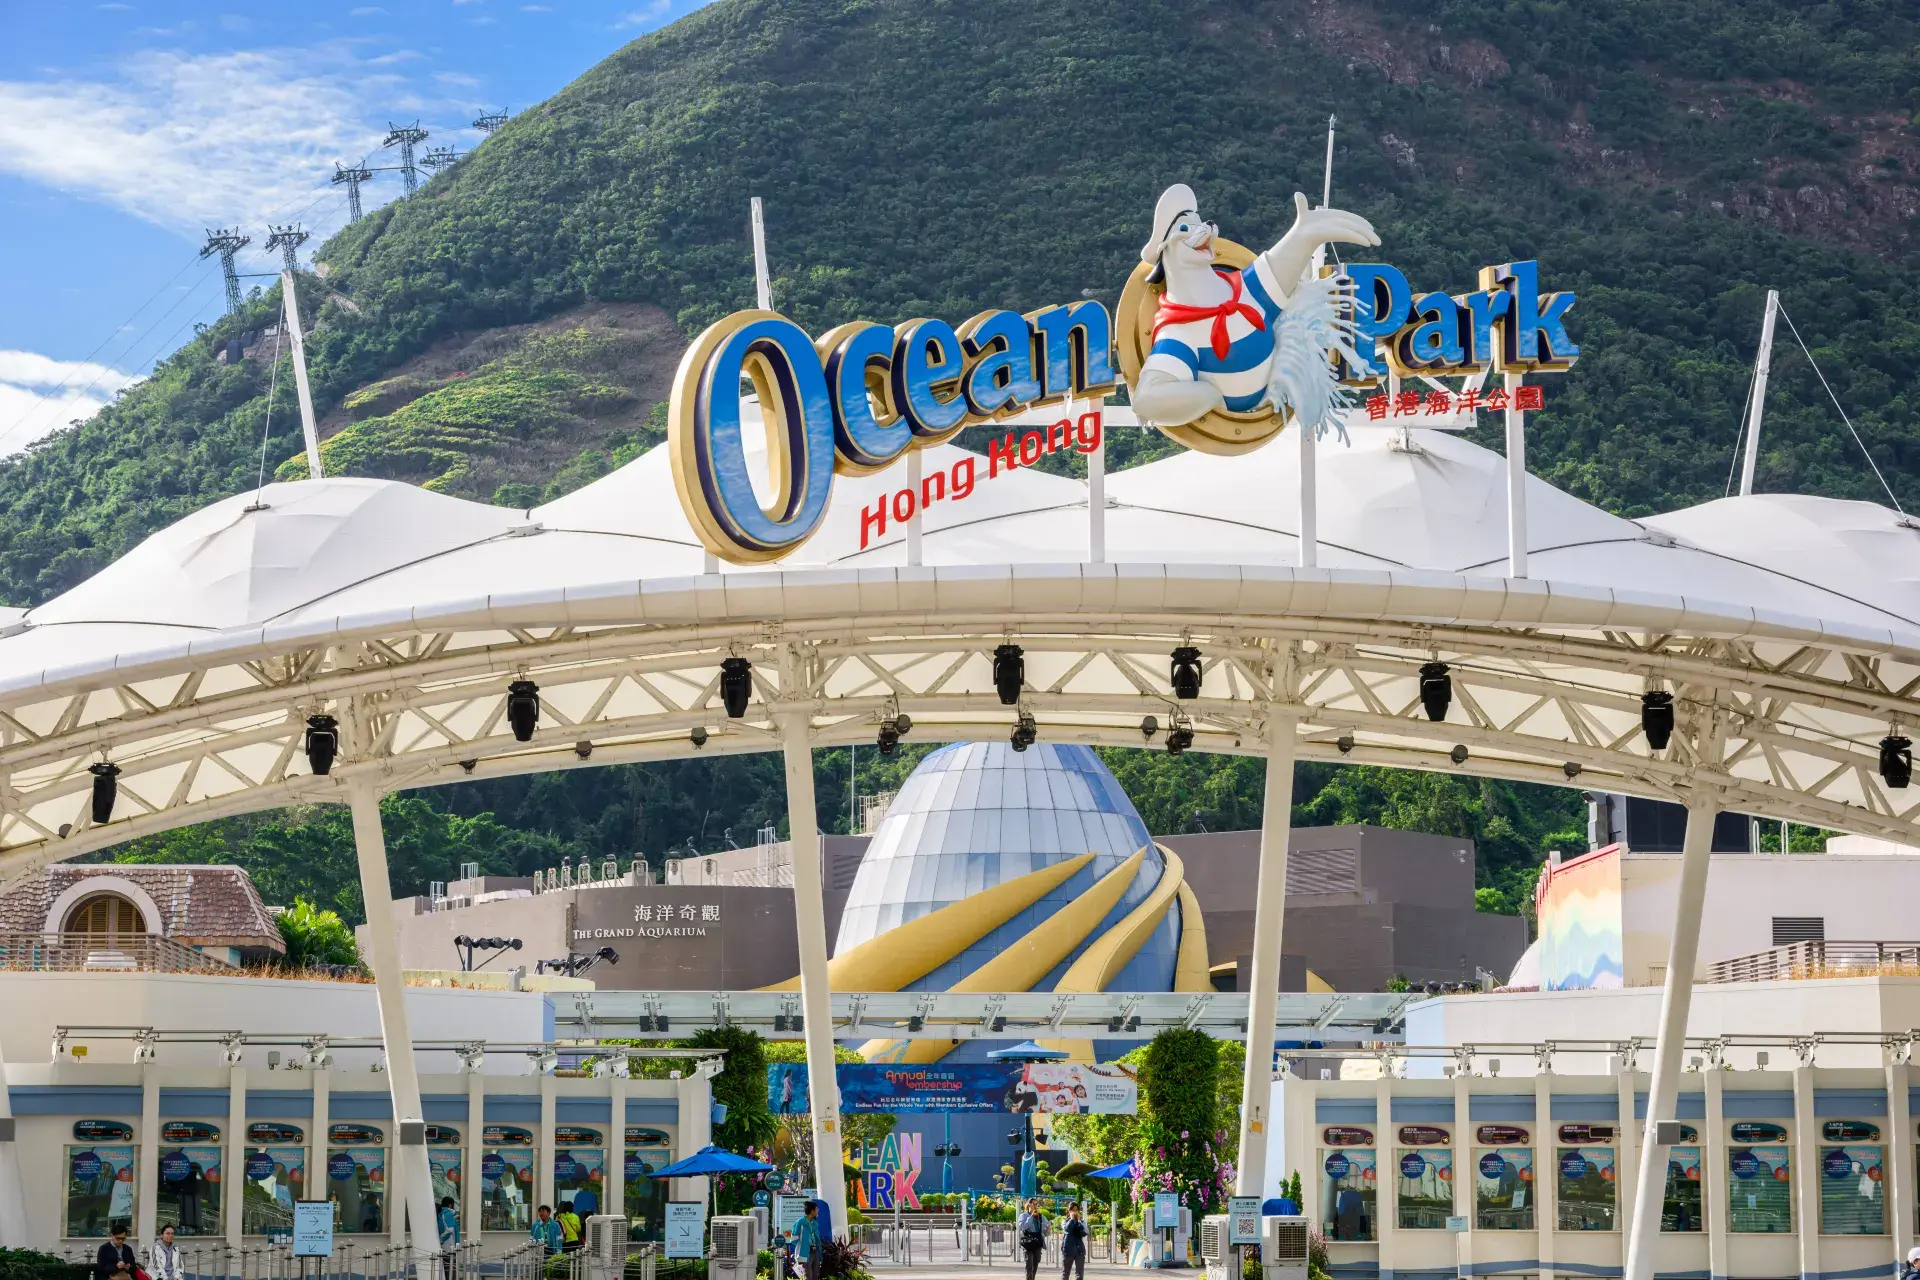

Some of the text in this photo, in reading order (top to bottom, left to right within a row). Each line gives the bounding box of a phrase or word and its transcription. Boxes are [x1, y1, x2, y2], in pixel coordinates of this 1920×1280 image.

[672, 260, 1580, 562] Ocean Park
[1365, 386, 1543, 421] 香港海洋公園
[861, 412, 1100, 550] Hong Kong
[634, 904, 720, 921] 海洋奇觀
[573, 926, 706, 940] THE GRAND AQUARIUM
[885, 1070, 926, 1083] Annual
